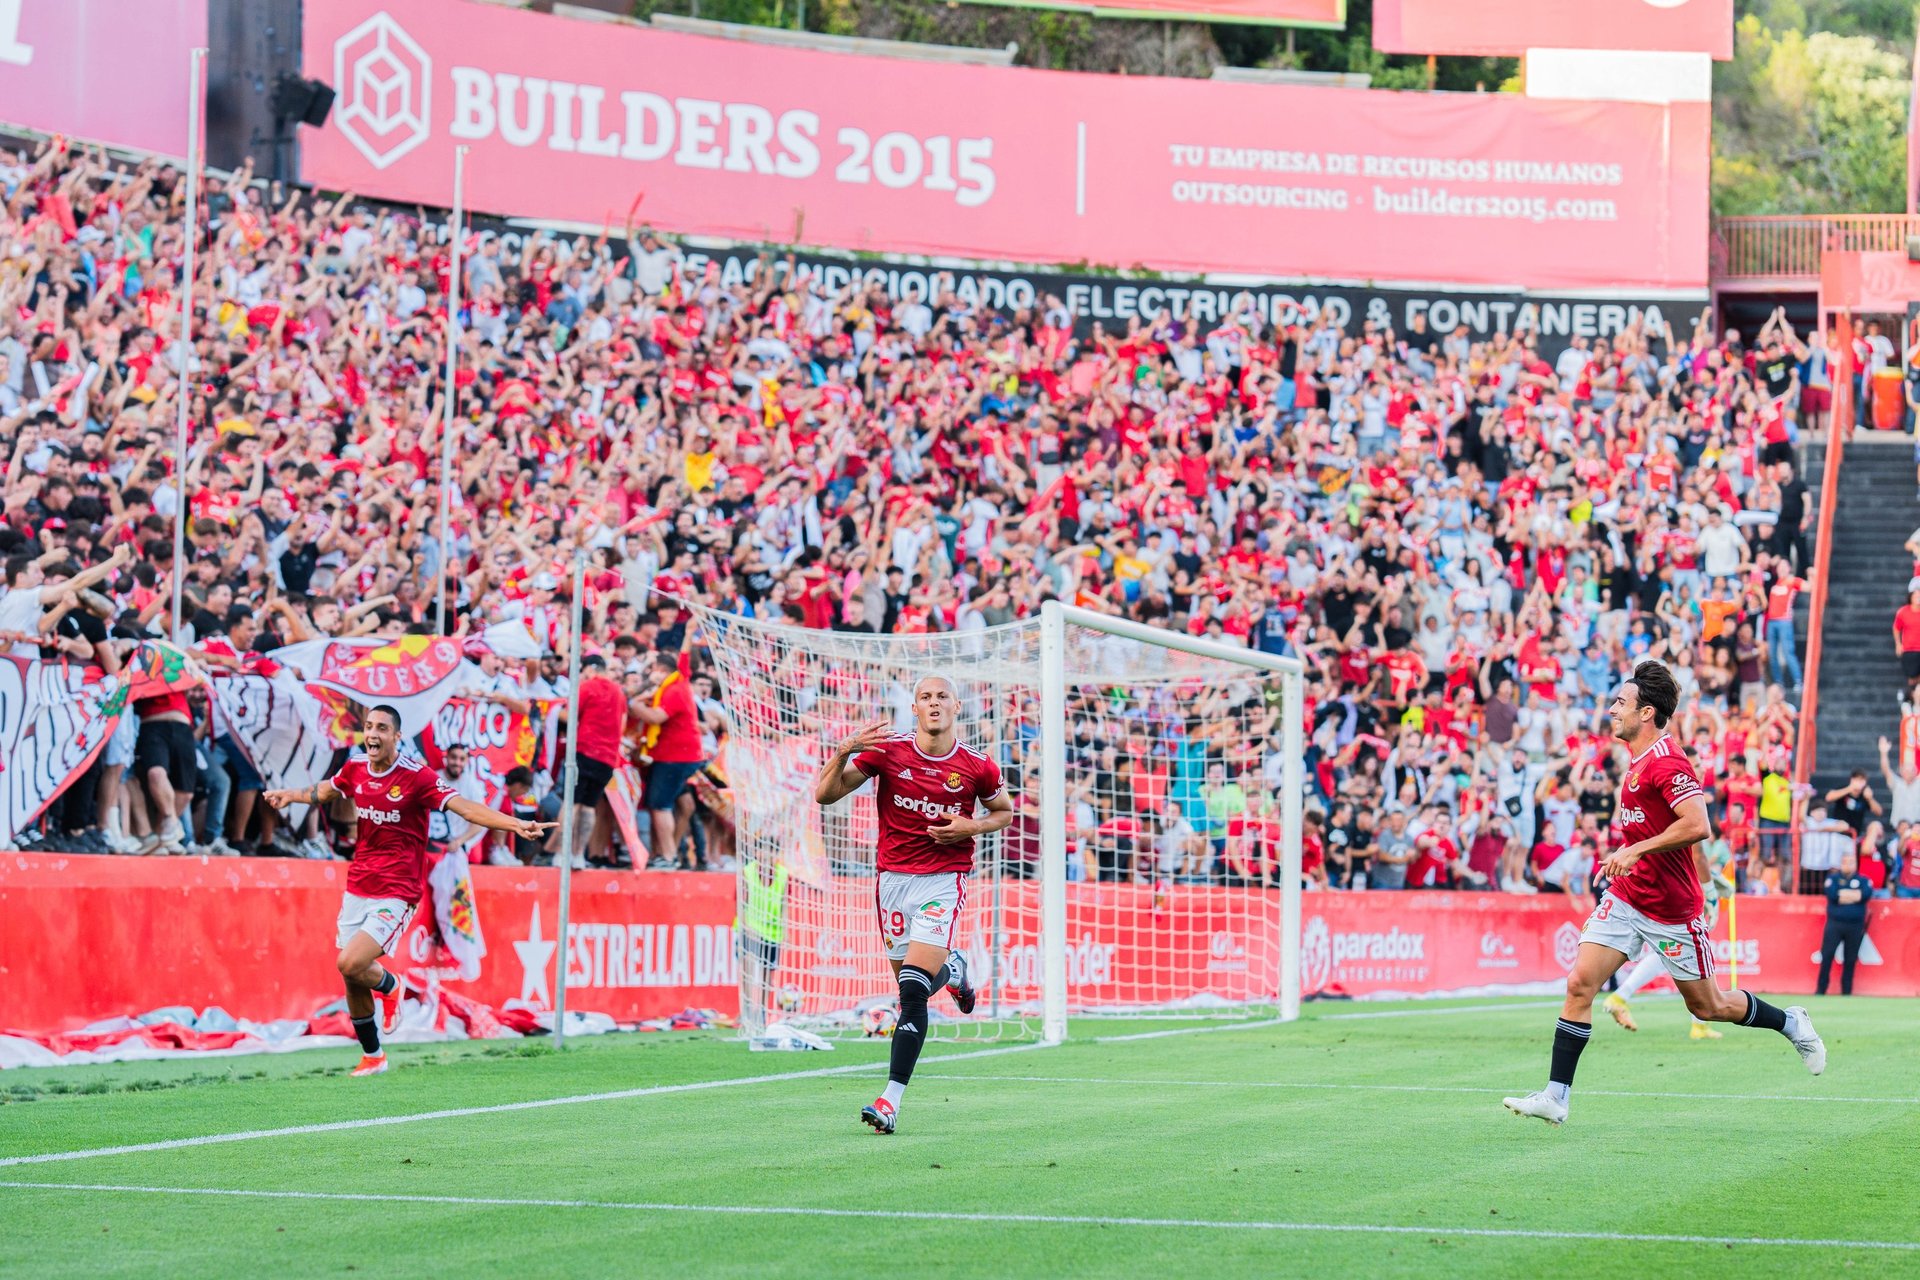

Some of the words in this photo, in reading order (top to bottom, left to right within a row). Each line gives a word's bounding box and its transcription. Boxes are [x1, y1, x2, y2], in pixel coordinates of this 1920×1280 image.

[450, 66, 821, 179] BUILDERS
[835, 127, 997, 207] 2015
[1169, 144, 1204, 167] TU
[1208, 147, 1322, 175] EMPRESA
[1326, 153, 1358, 175] DE
[1363, 155, 1490, 182] RECURSOS
[1494, 159, 1622, 185] HUMANOS
[1172, 180, 1349, 210] OUTSOURCING
[1373, 185, 1618, 222] builders2015.com
[565, 923, 691, 988] ESTRELLA
[1332, 926, 1425, 967] paradox
[1333, 966, 1427, 982] INTERACTIVE
